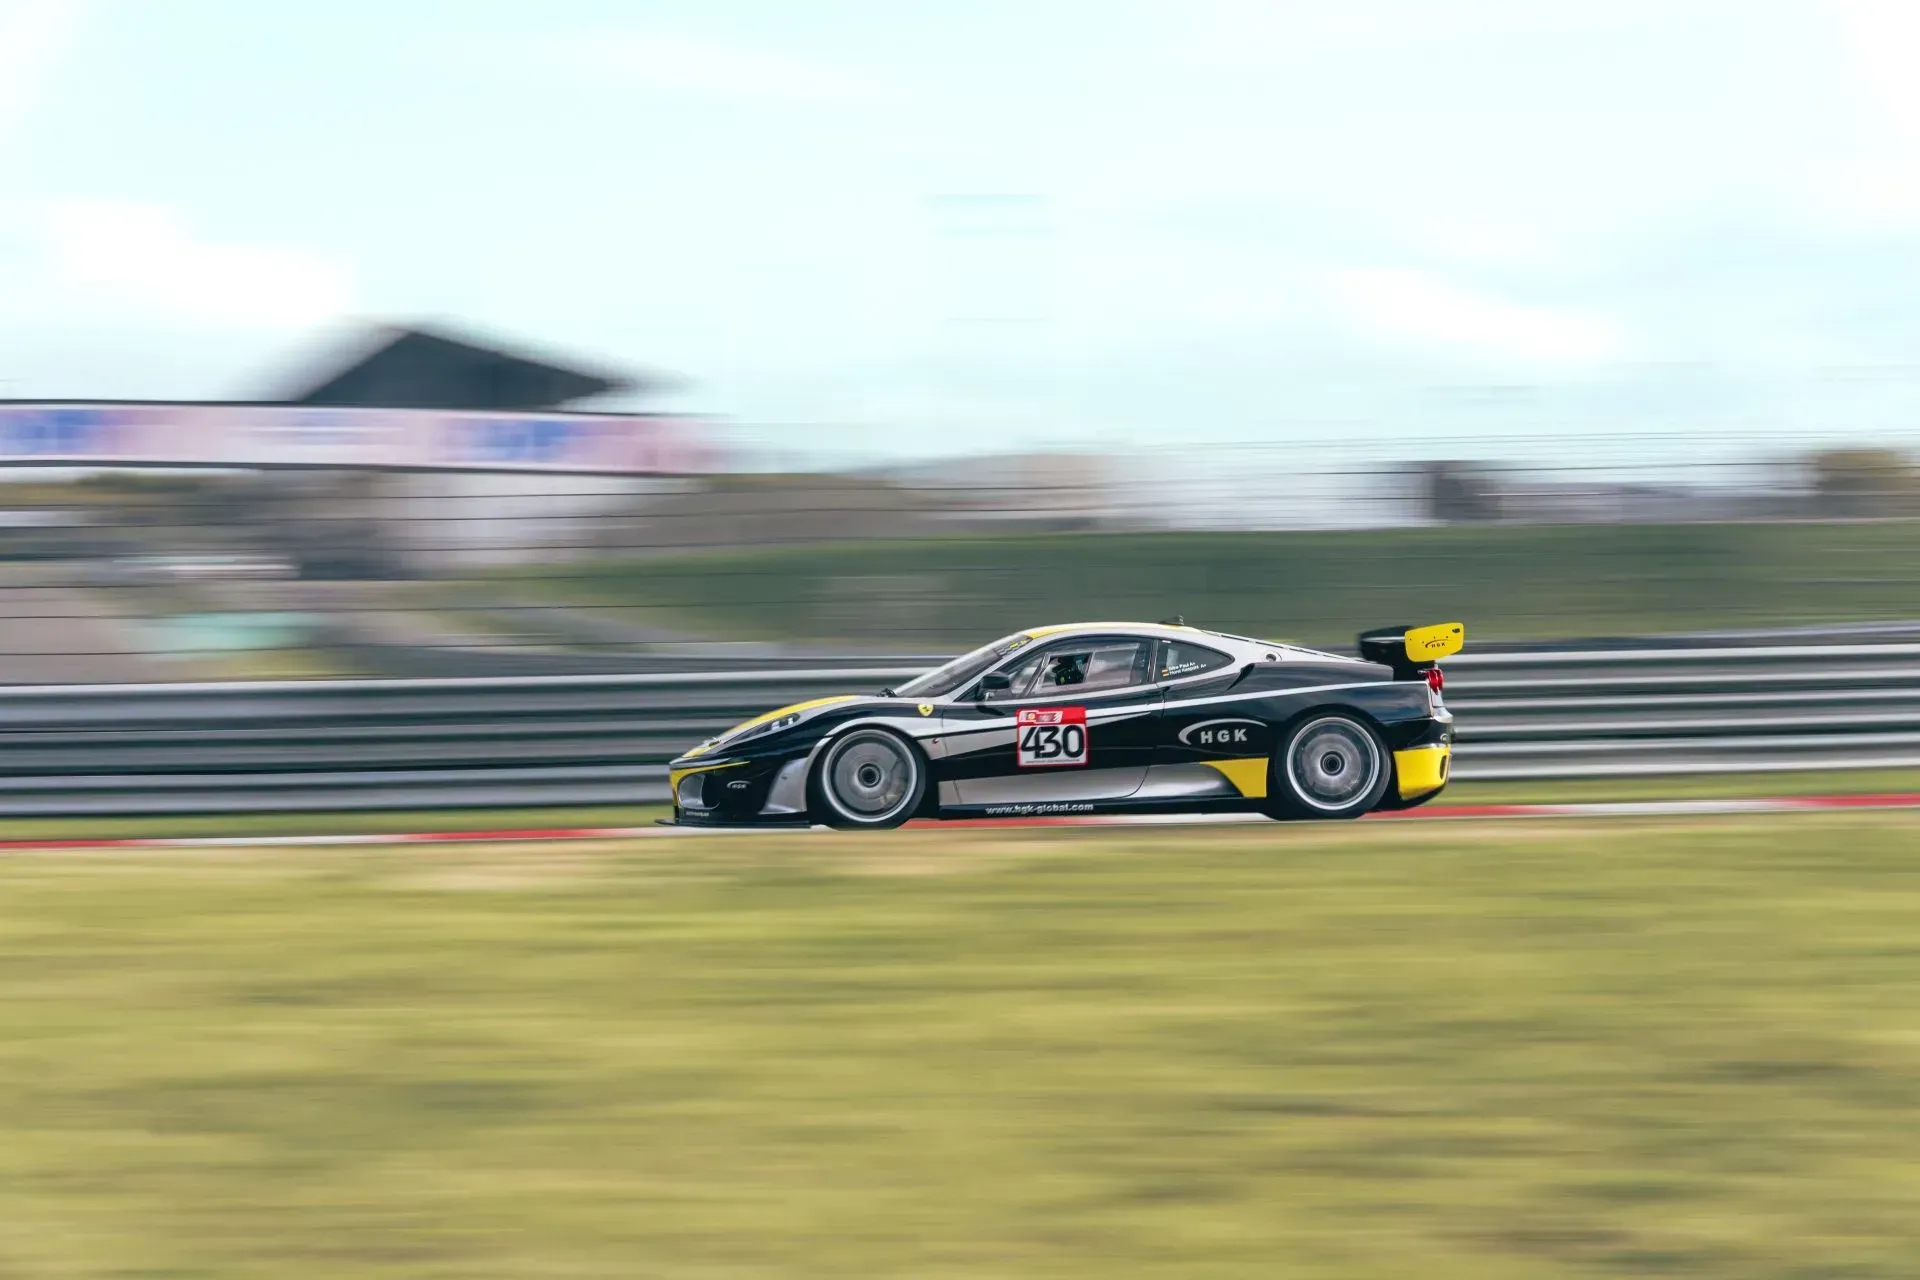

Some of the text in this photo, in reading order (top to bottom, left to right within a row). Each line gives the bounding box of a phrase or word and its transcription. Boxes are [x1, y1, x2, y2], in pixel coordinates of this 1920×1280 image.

[1021, 725, 1084, 759] 430
[1200, 728, 1247, 744] HGK
[985, 803, 1094, 814] www.hgk-global.com
